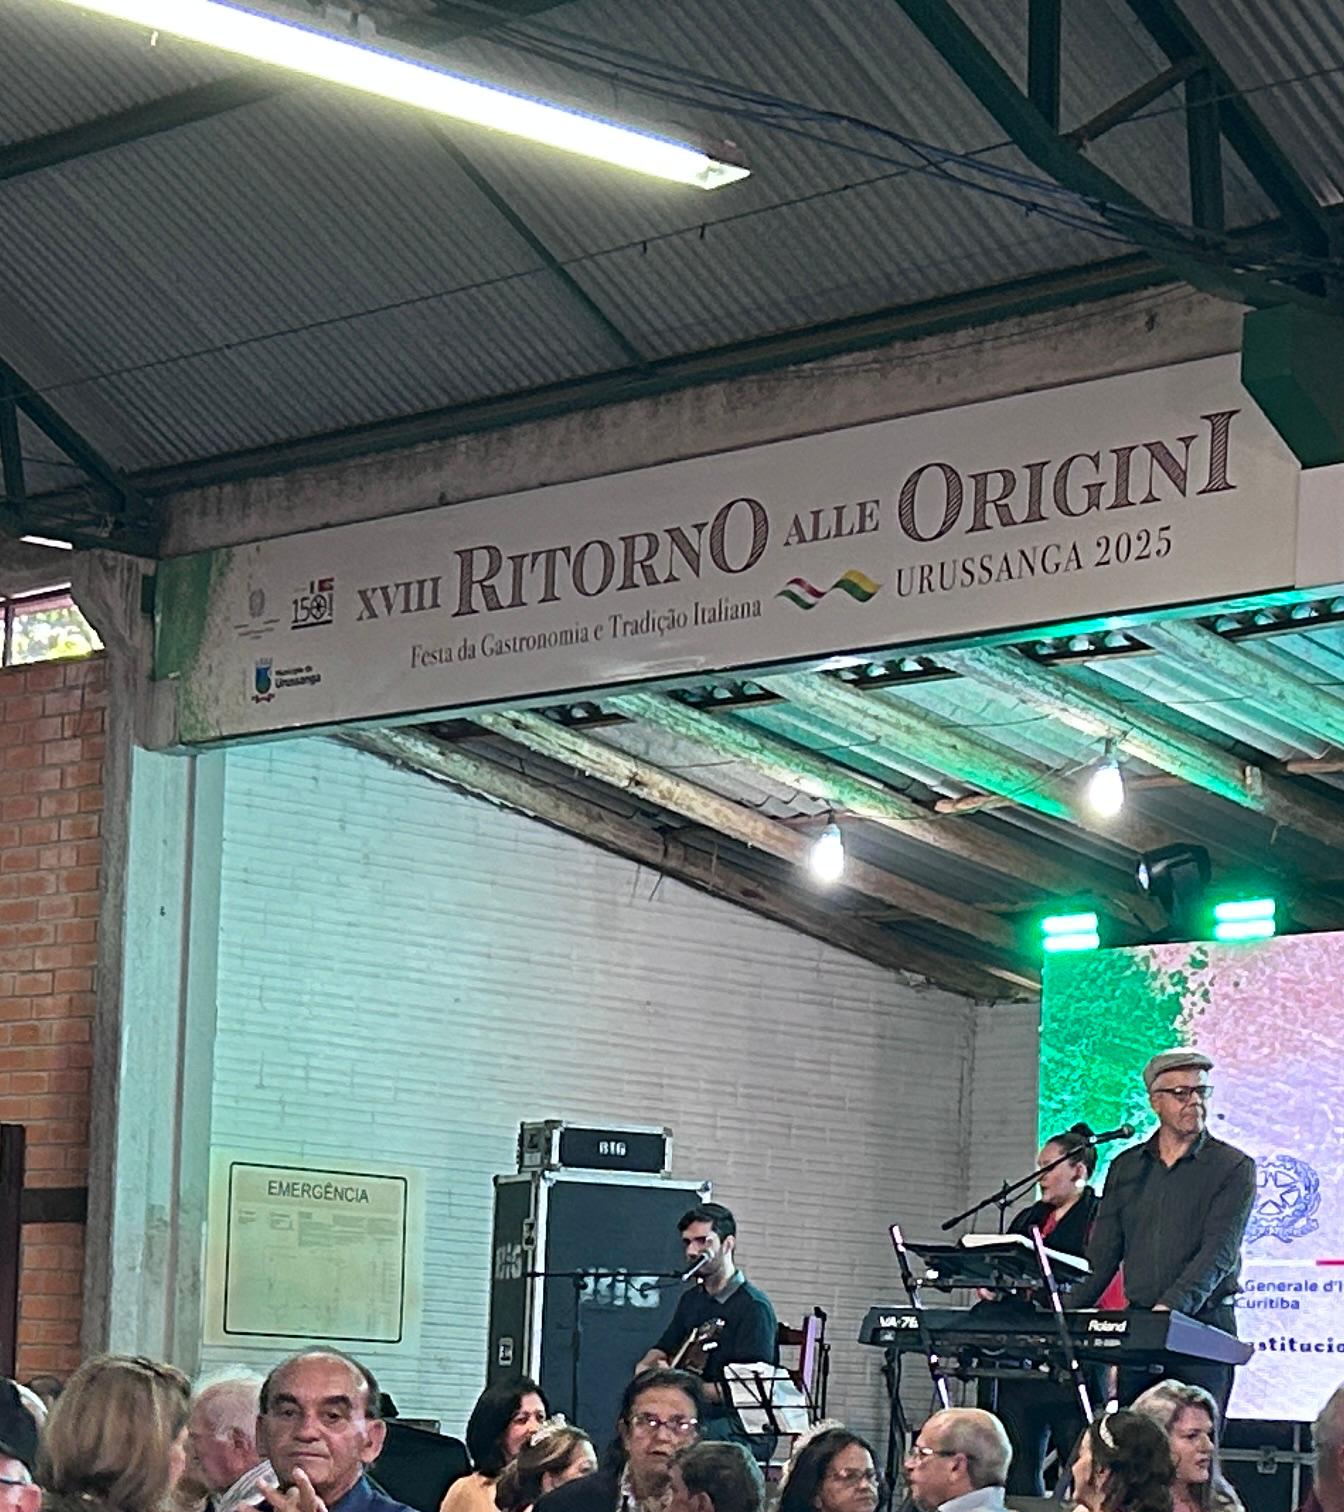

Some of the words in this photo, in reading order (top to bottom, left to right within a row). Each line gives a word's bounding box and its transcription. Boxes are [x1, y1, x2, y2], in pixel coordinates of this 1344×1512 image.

[356, 575, 443, 622] XVIII
[451, 497, 770, 618] RITORNO
[783, 499, 881, 547] ALLE
[897, 409, 1242, 543] ORIGINI
[895, 541, 1084, 598] URUSSANGA
[1095, 524, 1174, 568] 2025
[410, 642, 455, 668] Festa
[457, 638, 477, 661] da
[481, 625, 589, 658] Gastronomia
[593, 625, 605, 642] e
[608, 606, 688, 640] Tradição
[692, 597, 762, 627] Italiana
[267, 1179, 370, 1204] EMERGÊNCIA
[1245, 1279, 1319, 1293] Generale
[1235, 1296, 1301, 1310] Curitiba
[1087, 1319, 1128, 1333] Roland
